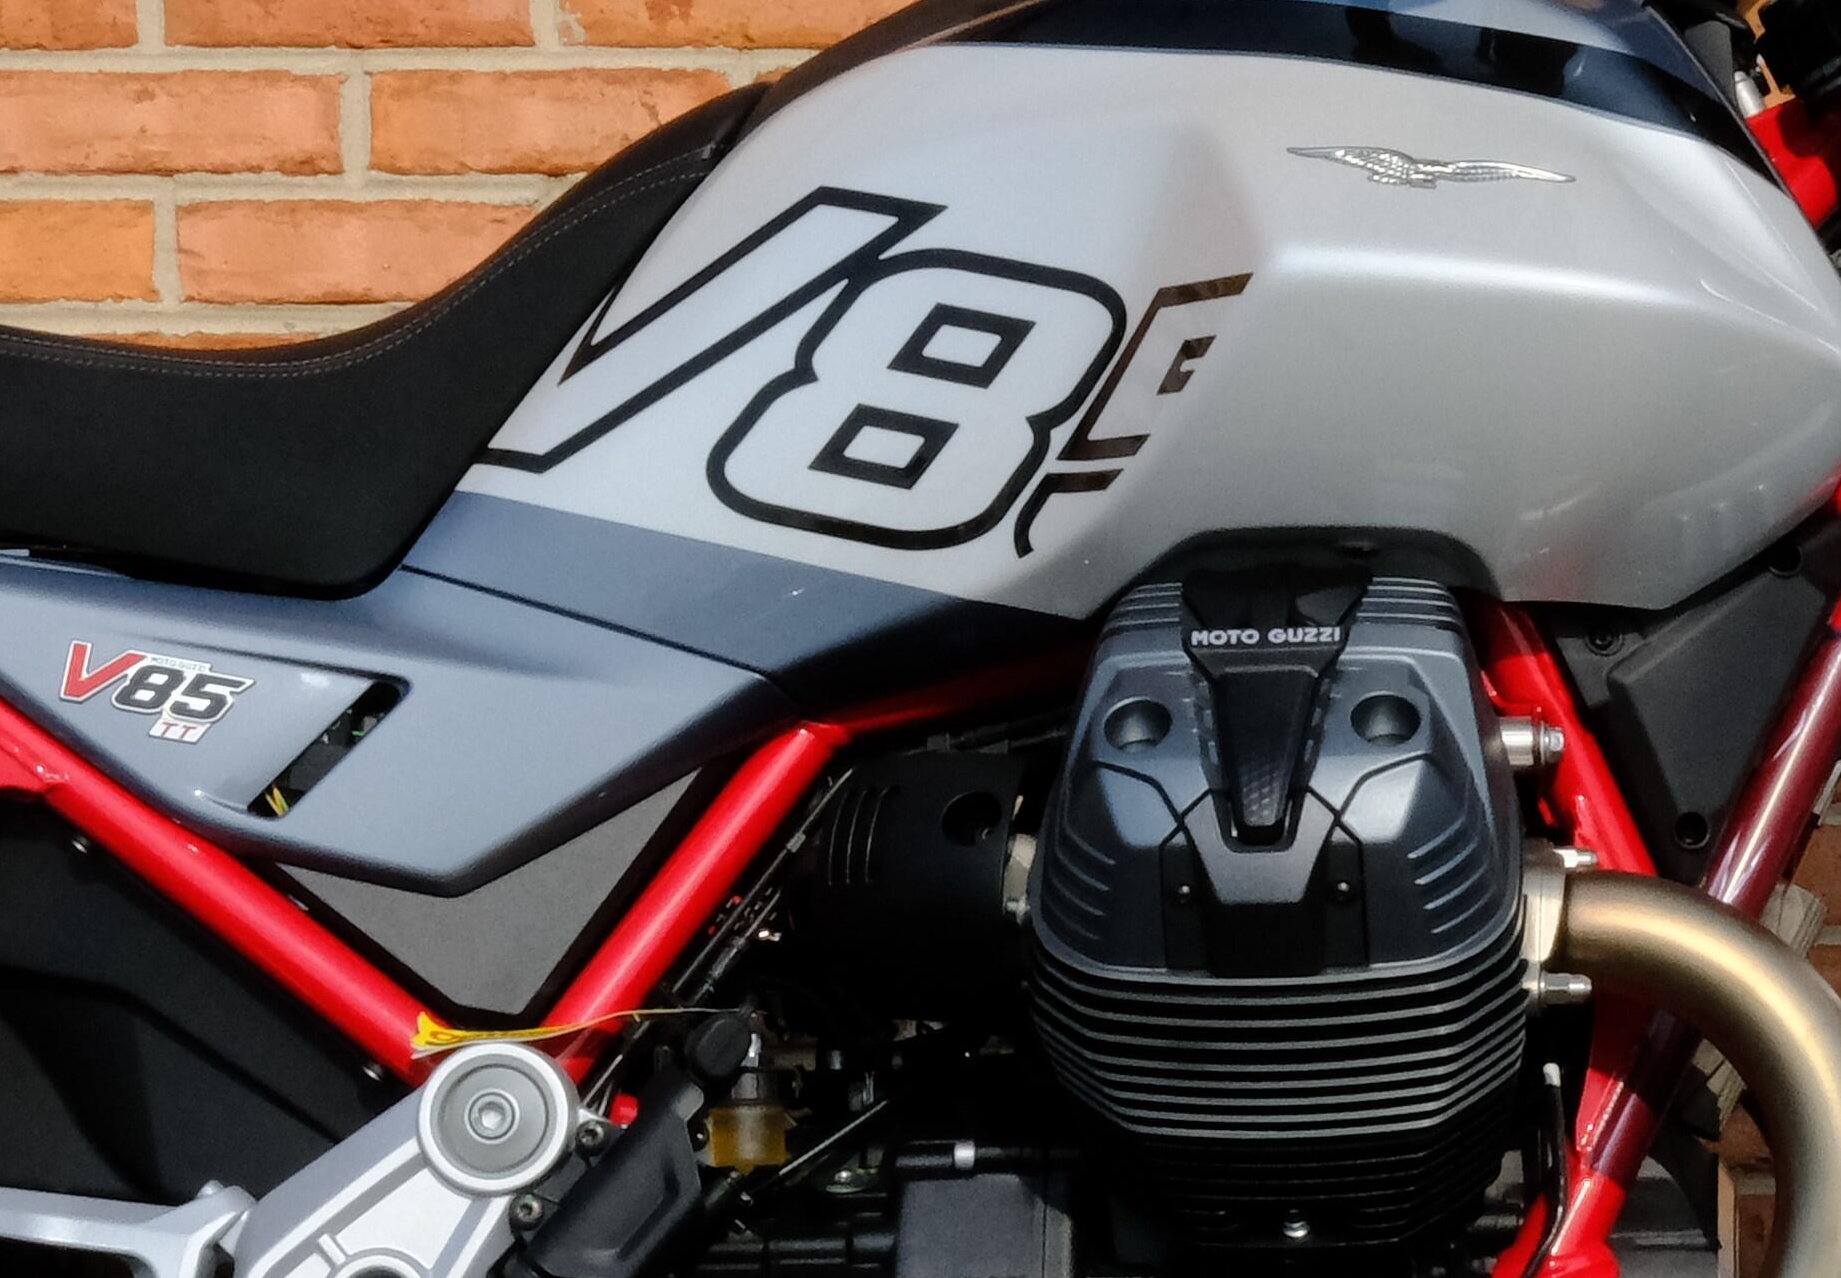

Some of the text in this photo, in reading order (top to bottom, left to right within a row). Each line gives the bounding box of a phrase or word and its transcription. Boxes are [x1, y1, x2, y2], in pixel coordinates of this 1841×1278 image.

[1191, 627, 1340, 645] MOTO GUZZI
[63, 643, 245, 720] V85
[162, 723, 196, 739] TT
